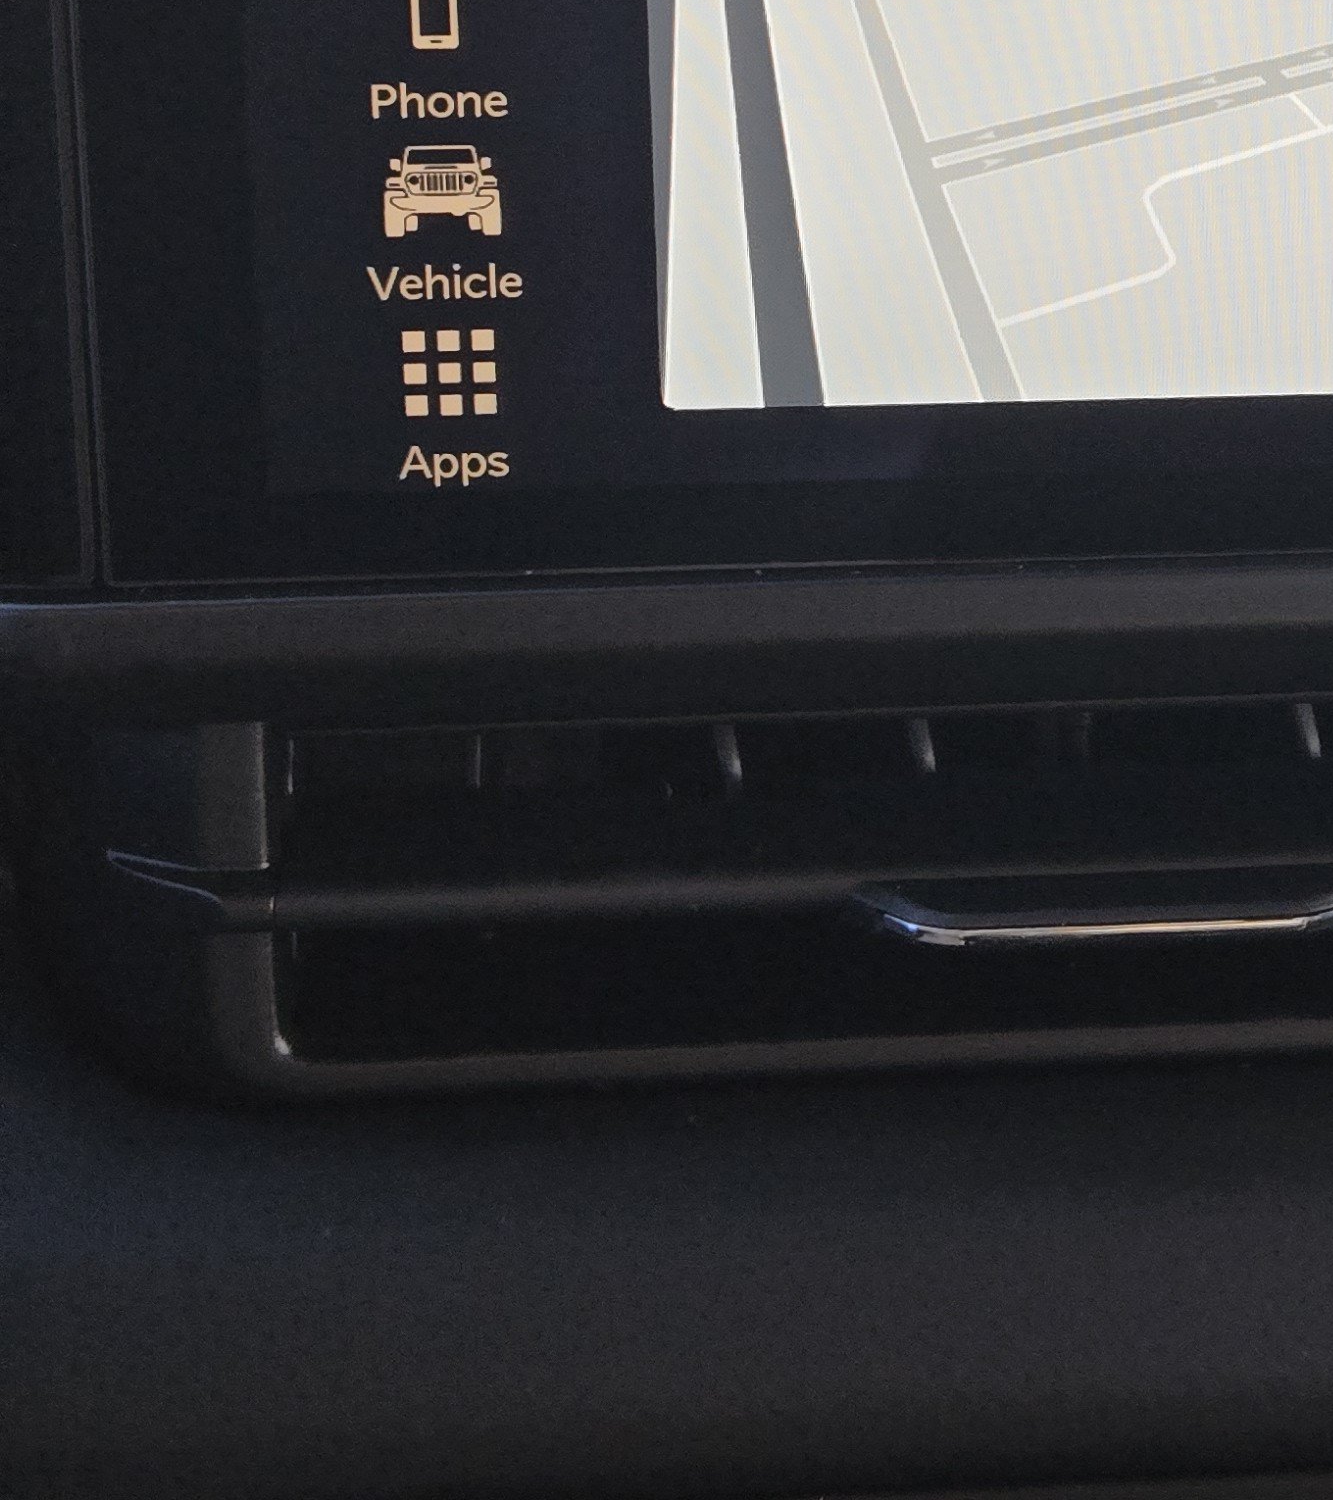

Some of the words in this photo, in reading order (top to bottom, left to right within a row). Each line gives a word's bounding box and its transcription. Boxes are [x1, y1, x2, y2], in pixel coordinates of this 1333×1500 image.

[370, 82, 509, 119] Phone
[366, 262, 524, 301] Vehicle
[399, 445, 511, 487] Apps
